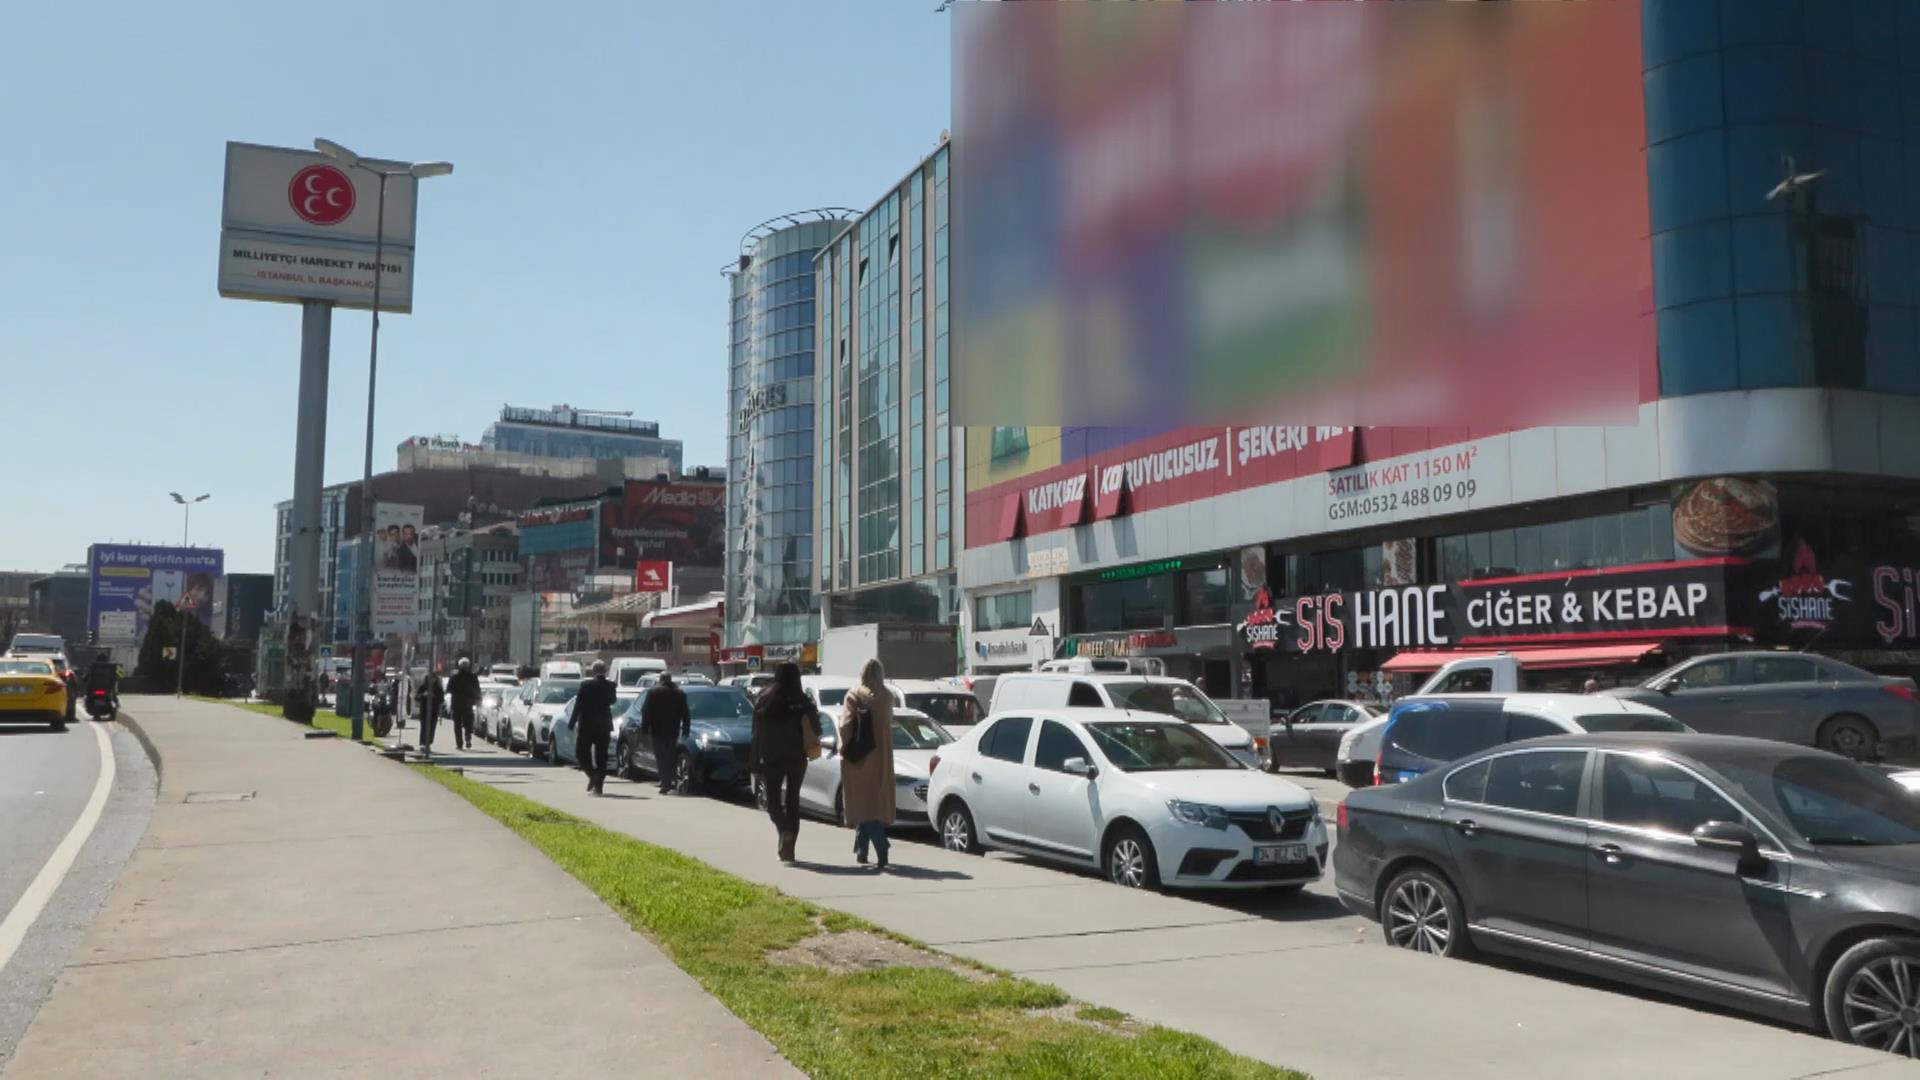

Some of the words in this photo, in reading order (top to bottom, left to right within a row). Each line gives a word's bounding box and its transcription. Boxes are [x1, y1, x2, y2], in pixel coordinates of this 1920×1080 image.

[301, 256, 353, 269] HAREKET
[1028, 473, 1088, 514] KATKISIZ
[1100, 437, 1219, 494] KORUYUCUSUZ
[1328, 470, 1378, 496] SATILIK
[1382, 464, 1409, 485] KAT
[1415, 456, 1452, 480] 1150
[1329, 493, 1398, 520] GSM:0532
[1401, 487, 1430, 507] 488
[1433, 483, 1453, 503] 09
[1456, 479, 1477, 499] 09
[1355, 584, 1448, 647] HANE
[1466, 589, 1552, 628] CİĞER
[1561, 592, 1583, 623] &
[1592, 583, 1708, 621] KEBAP
[1873, 565, 1920, 643] Şİ
